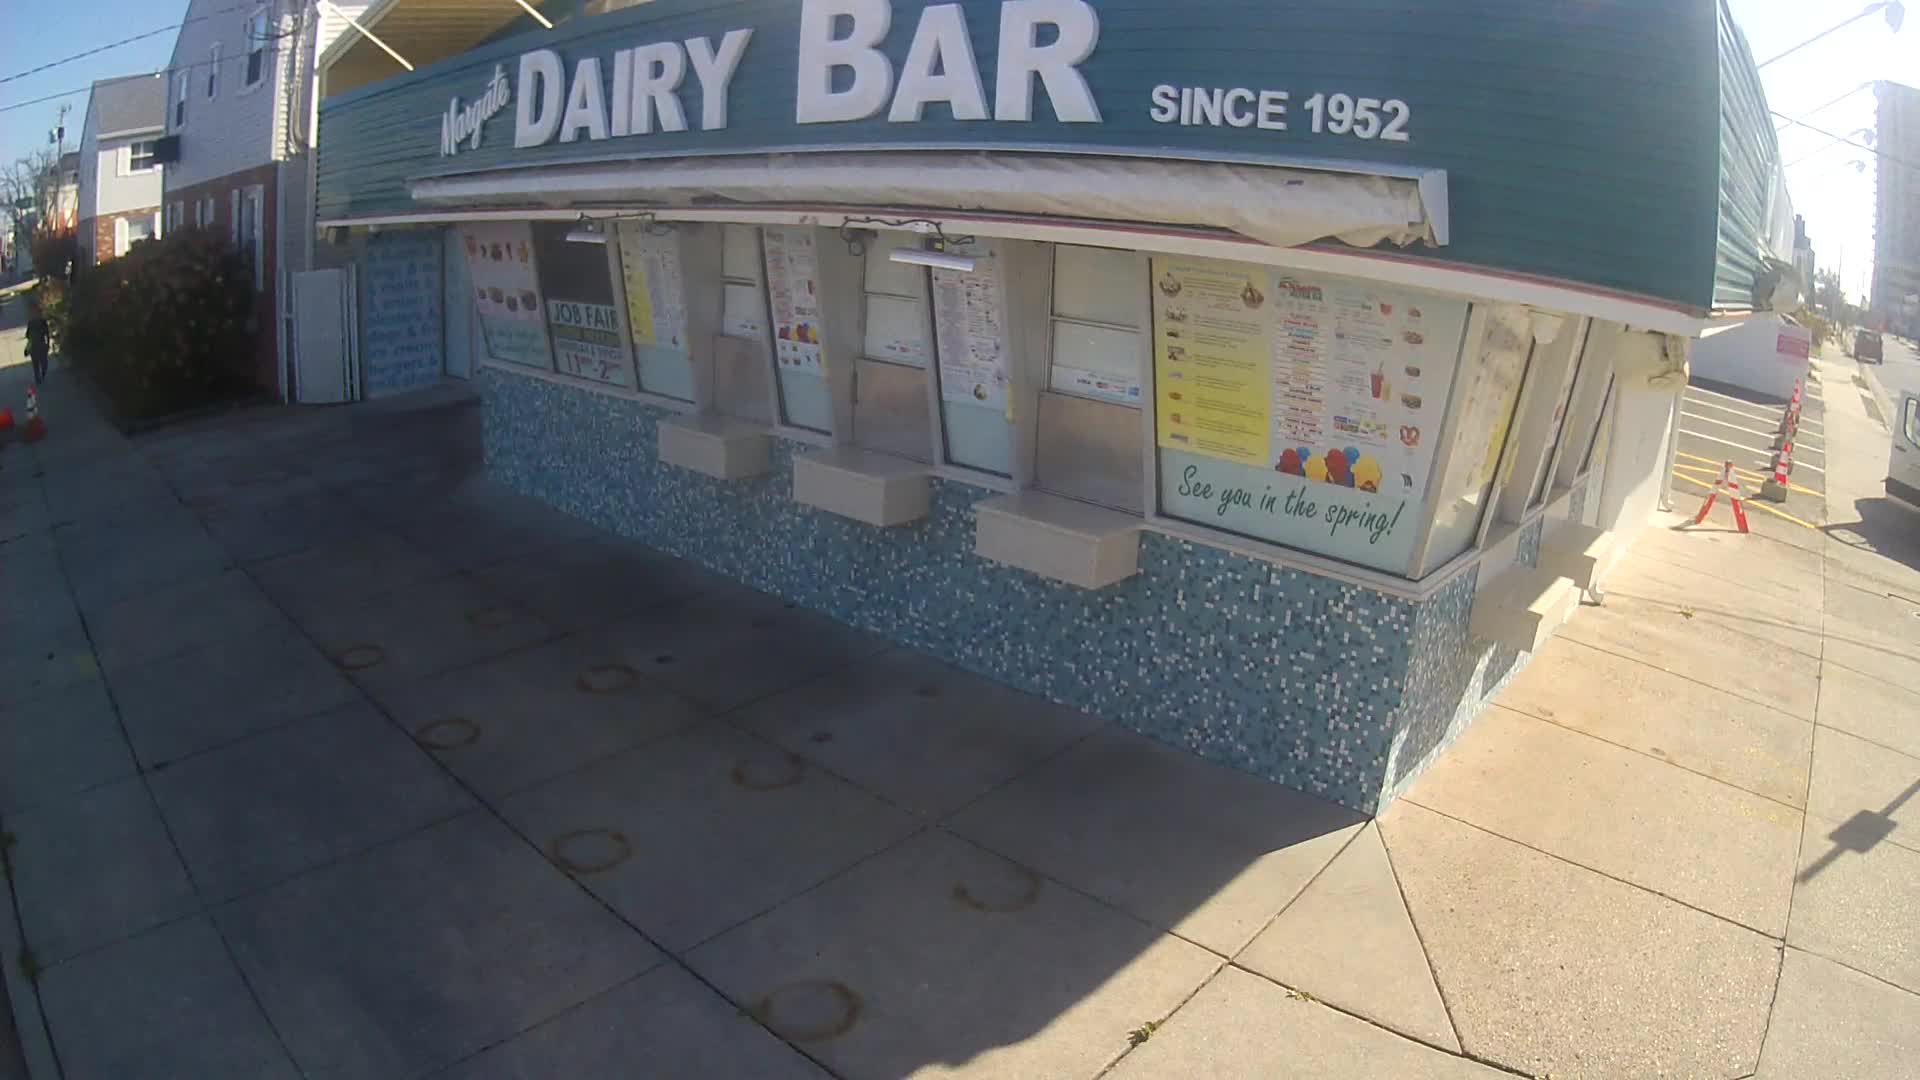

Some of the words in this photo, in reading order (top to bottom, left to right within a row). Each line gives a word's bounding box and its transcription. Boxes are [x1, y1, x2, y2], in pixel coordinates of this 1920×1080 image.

[441, 63, 511, 157] Margate
[514, 28, 753, 148] DAIRY
[796, 0, 1103, 124] BAR
[1150, 85, 1289, 130] SINCE
[1304, 93, 1410, 141] 1952
[554, 304, 582, 326] JOB
[1178, 465, 1214, 500] See
[1217, 488, 1252, 516] you
[1259, 485, 1276, 513] in
[1284, 486, 1317, 518] the
[1325, 501, 1405, 545] spring!
